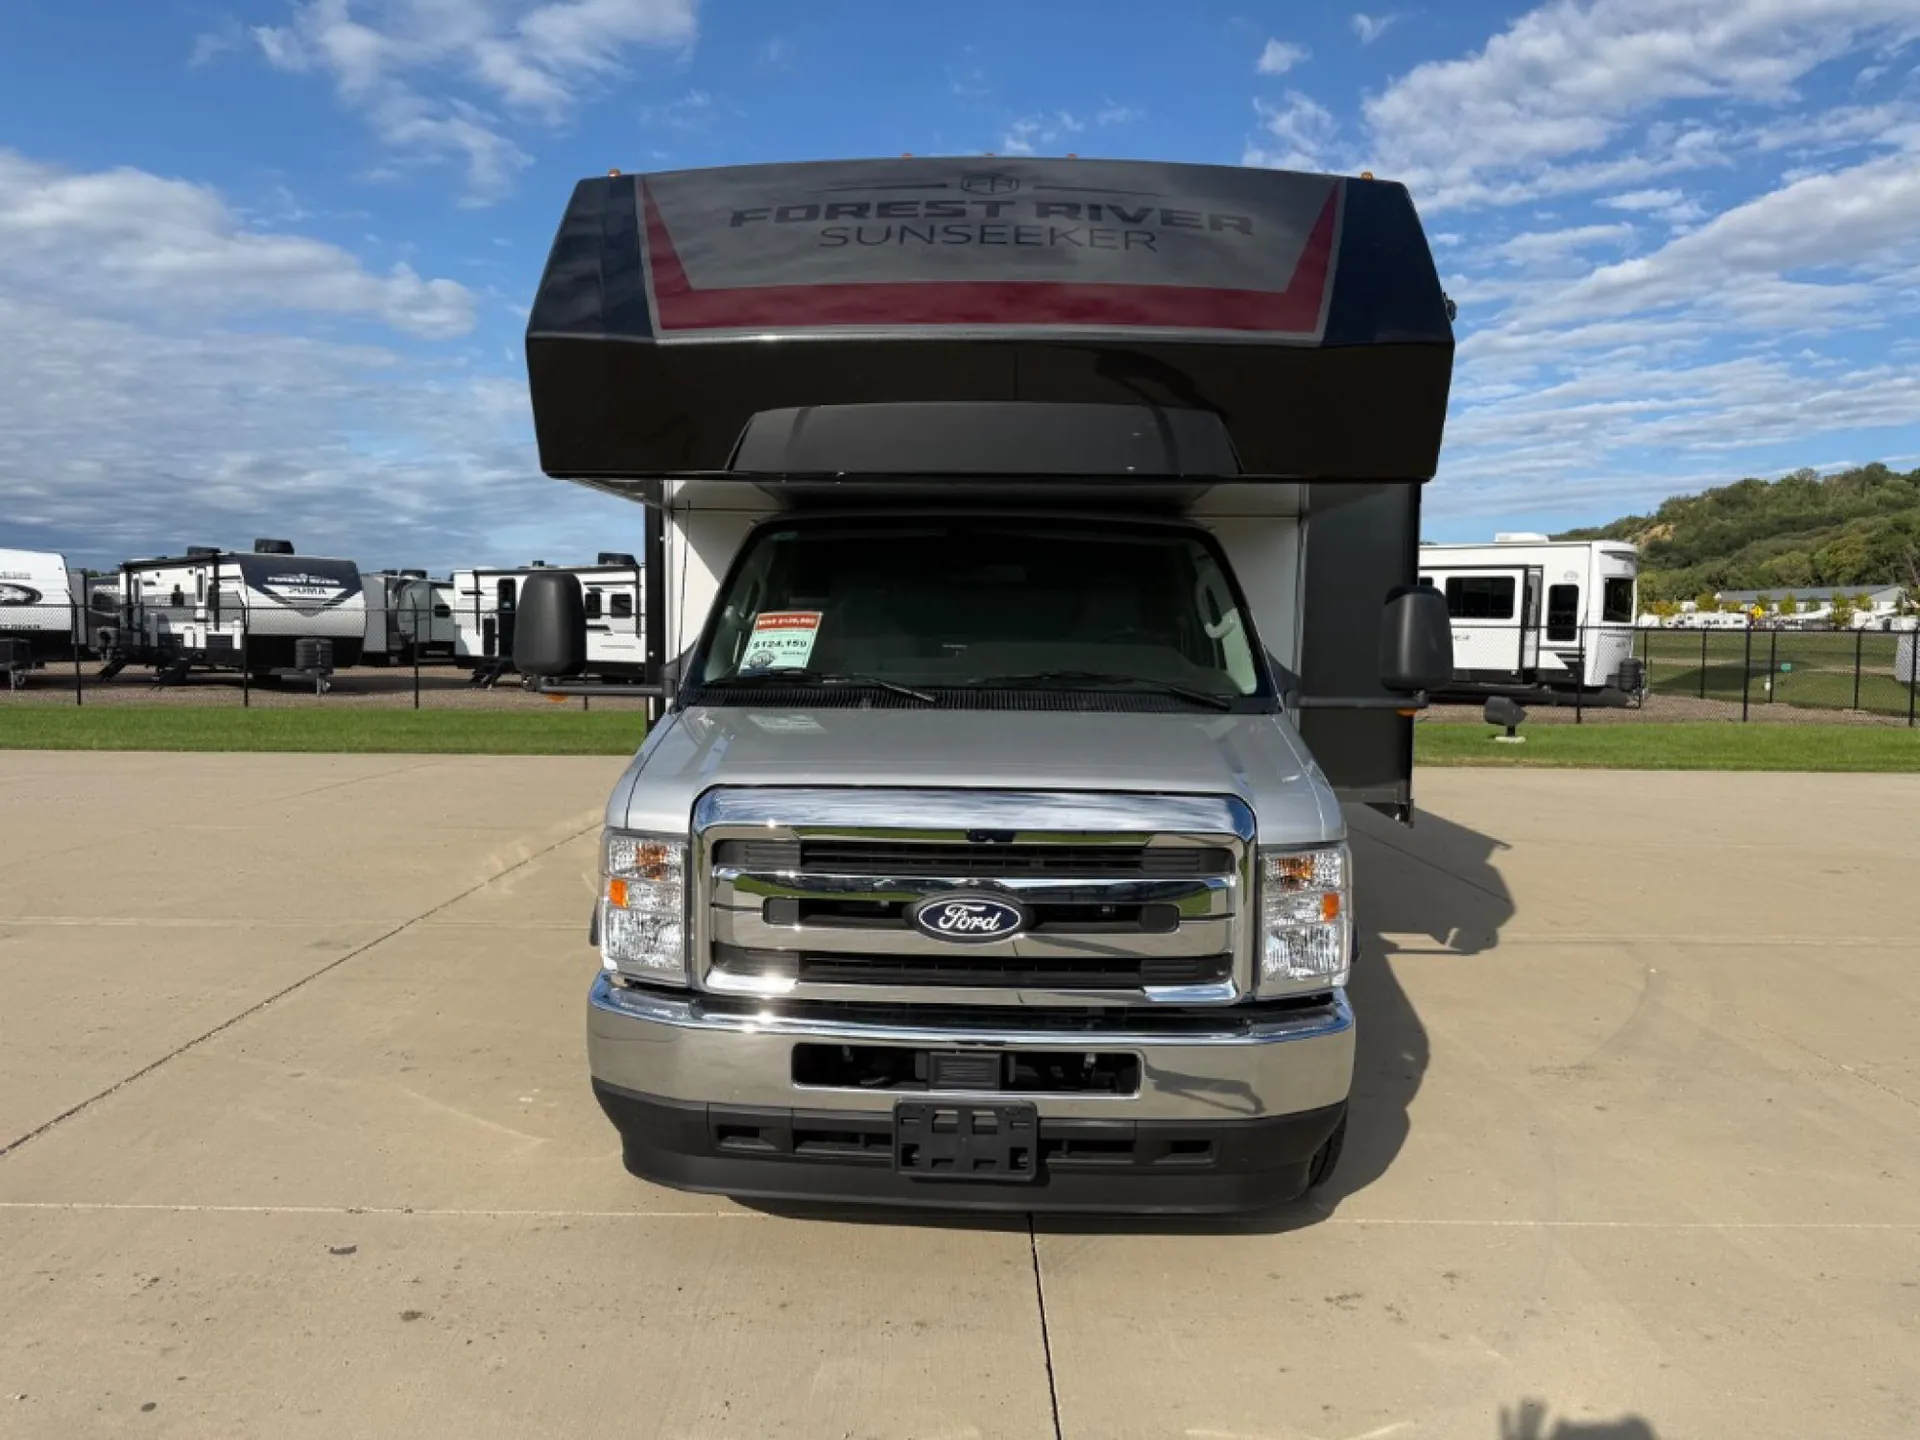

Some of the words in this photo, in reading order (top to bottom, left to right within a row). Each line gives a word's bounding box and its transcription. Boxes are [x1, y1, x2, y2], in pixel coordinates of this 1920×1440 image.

[729, 200, 1016, 227] FOREST
[1034, 200, 1253, 235] RIVER
[819, 224, 1157, 253] SUNSEEKER
[939, 904, 1002, 931] Ford
